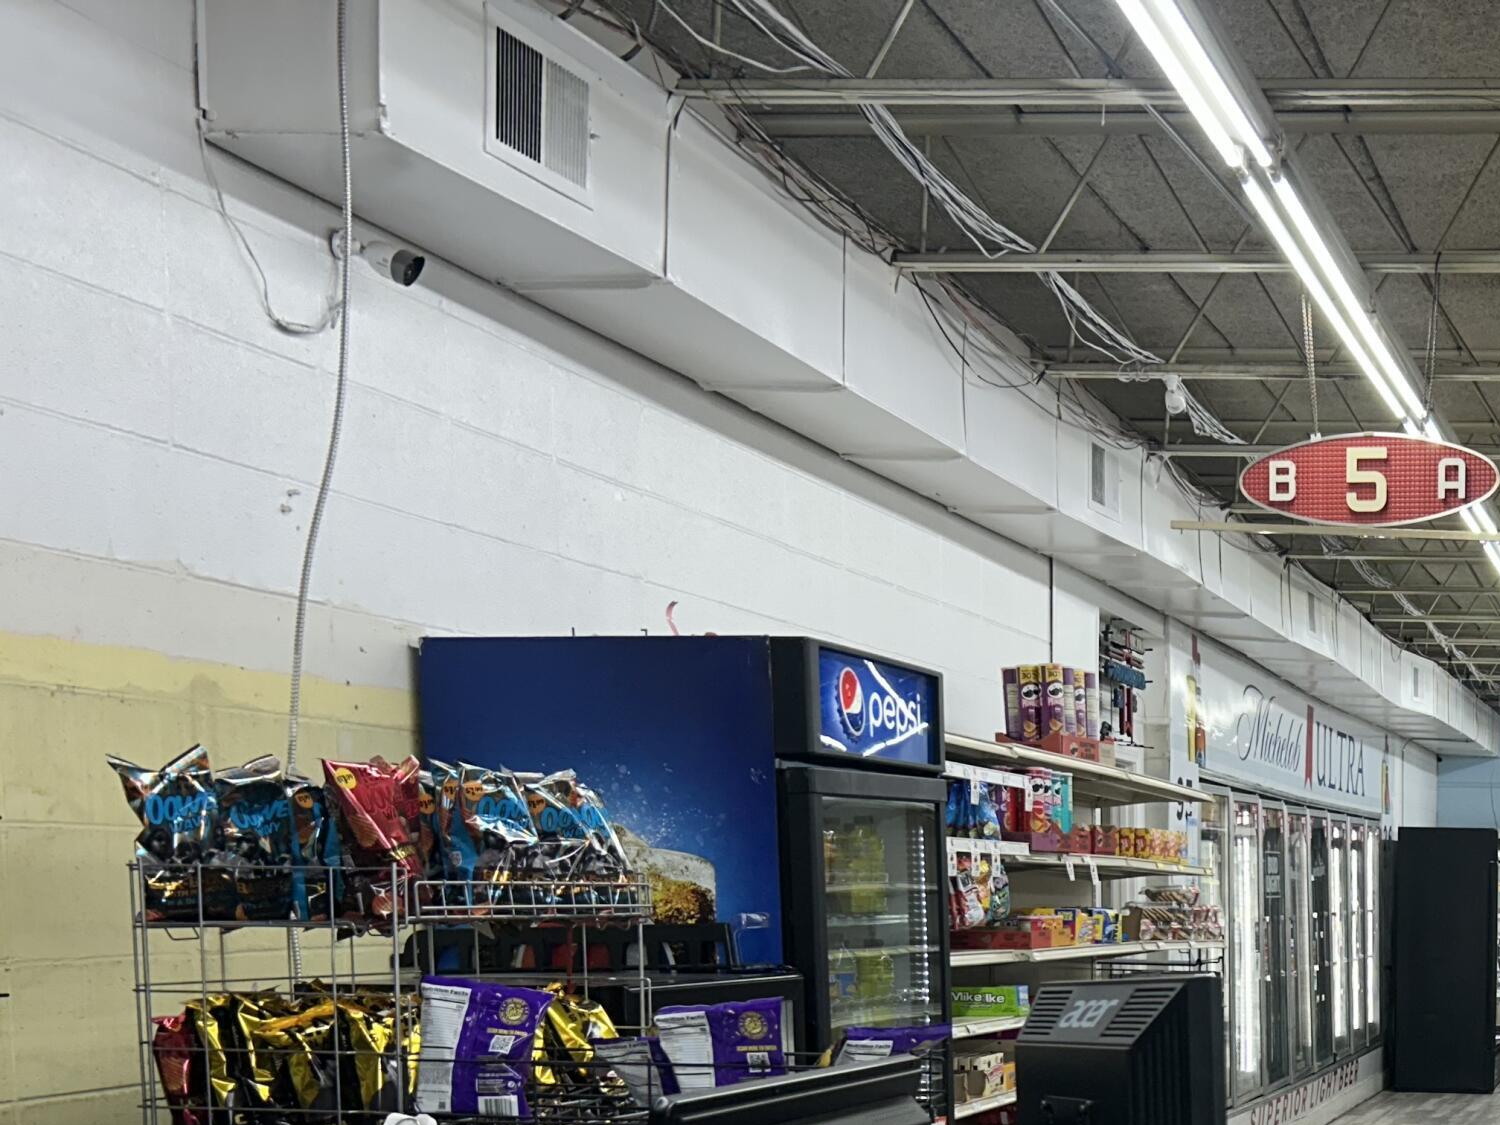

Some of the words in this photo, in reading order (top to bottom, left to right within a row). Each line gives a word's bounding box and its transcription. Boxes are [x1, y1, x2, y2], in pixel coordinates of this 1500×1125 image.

[1268, 460, 1296, 502] B
[1345, 446, 1388, 512] 5
[1437, 458, 1466, 500] A
[868, 691, 921, 738] pepsi
[1237, 684, 1303, 773] Michelob
[1315, 720, 1365, 797] ULTRA
[985, 994, 1005, 1003] Ike
[1309, 1069, 1337, 1109] LIGHT
[1338, 1058, 1360, 1091] BEER
